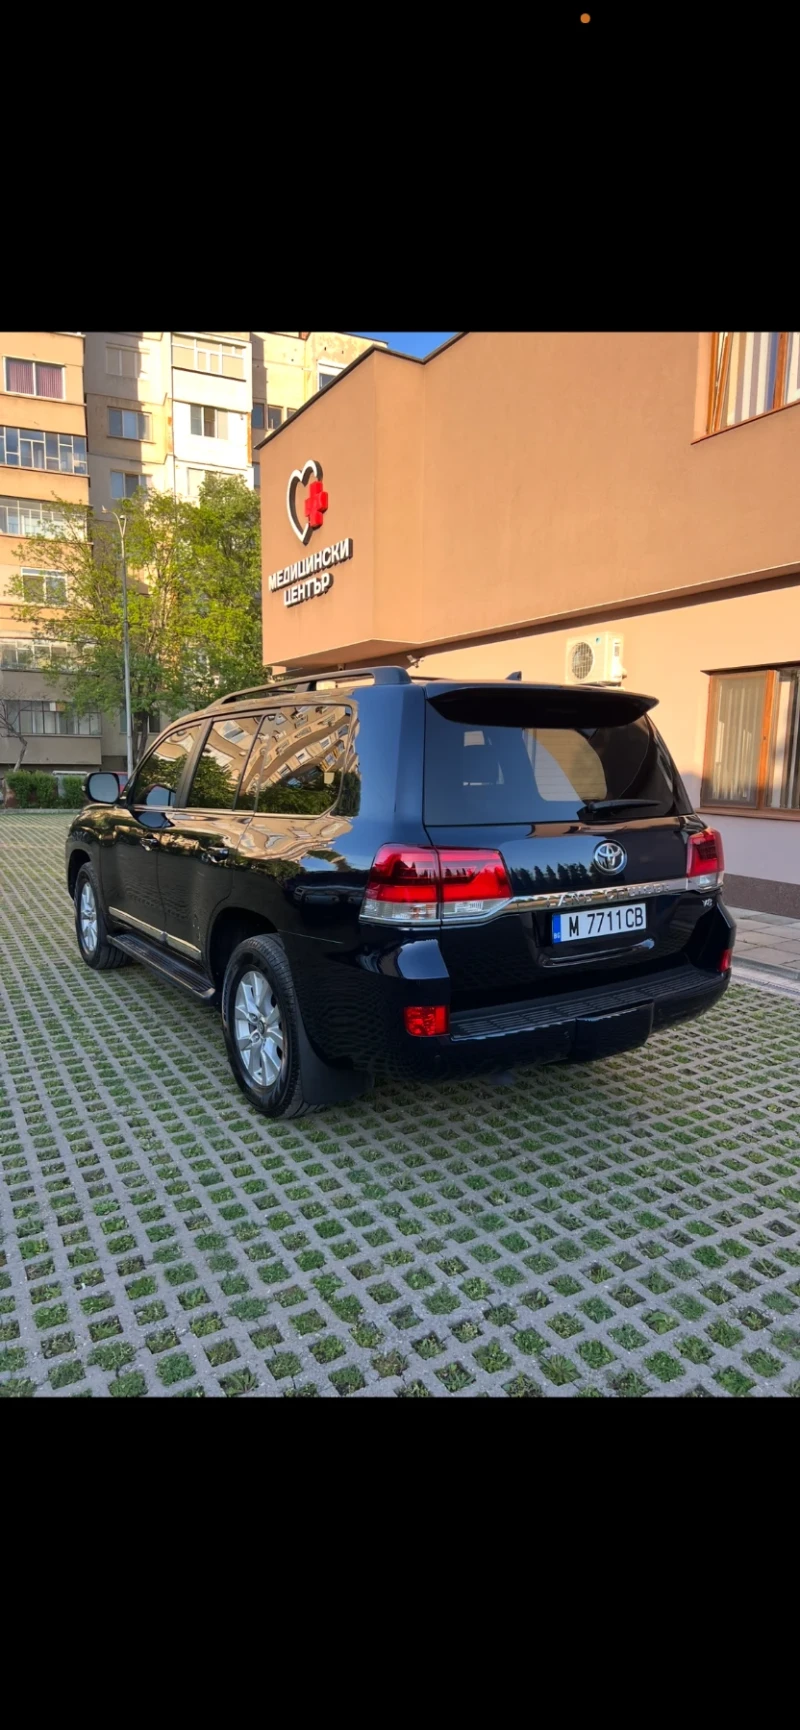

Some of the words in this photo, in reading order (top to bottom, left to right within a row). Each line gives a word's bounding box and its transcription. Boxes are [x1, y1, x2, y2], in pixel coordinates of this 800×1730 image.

[268, 537, 353, 592] МЕДИЦИНСКИ
[283, 572, 333, 607] ЦЕНТЪР
[569, 916, 580, 938] M
